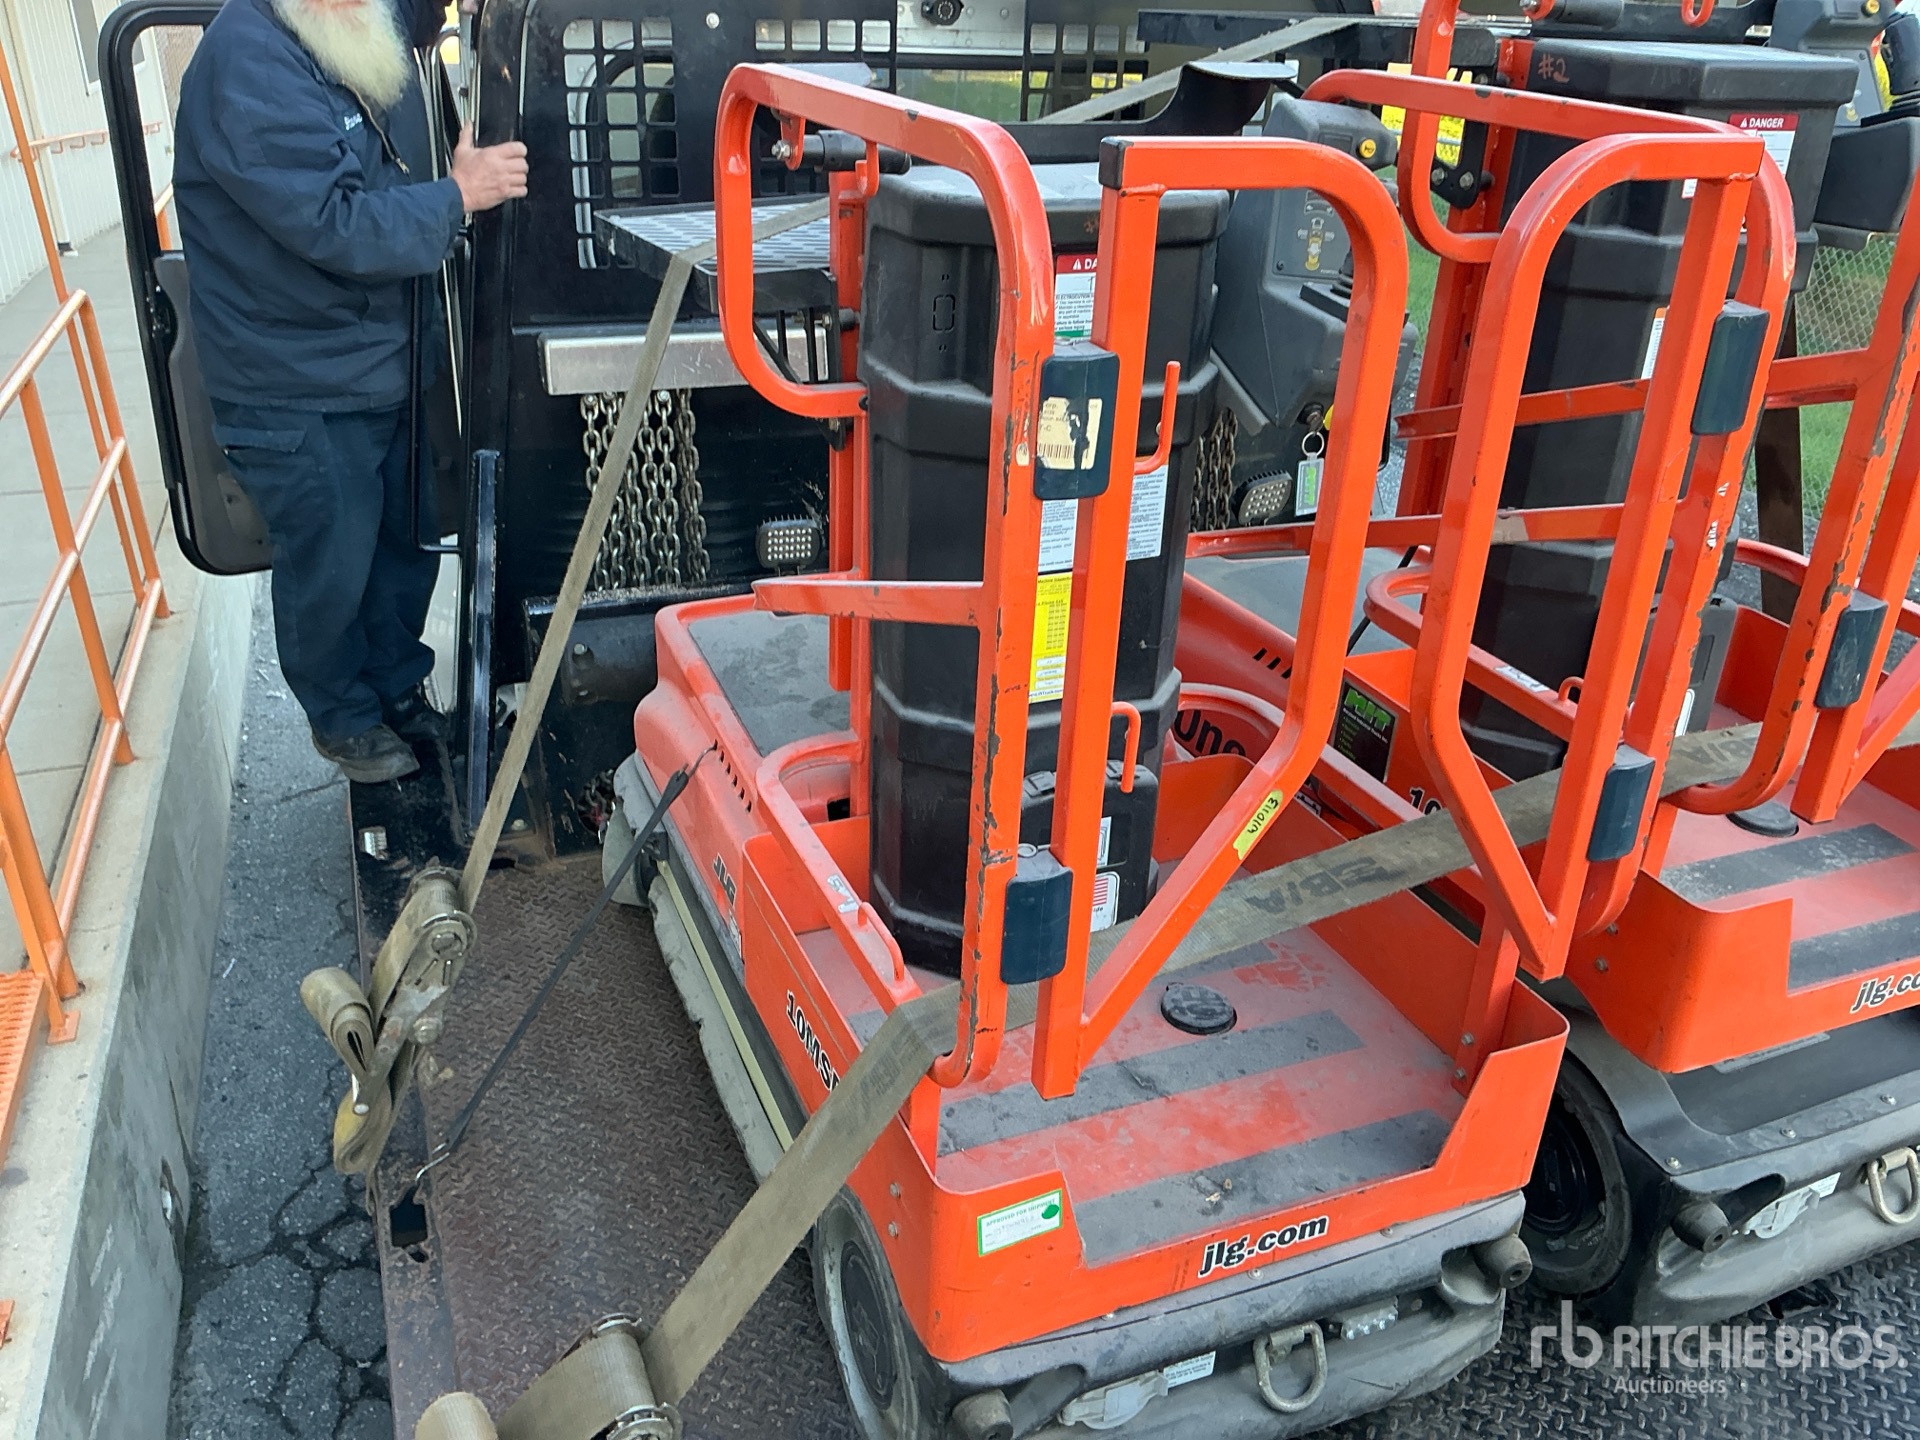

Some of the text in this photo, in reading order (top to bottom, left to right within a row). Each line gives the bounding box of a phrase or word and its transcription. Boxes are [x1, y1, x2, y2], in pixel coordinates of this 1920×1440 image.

[1538, 54, 1569, 83] #2
[1749, 117, 1784, 128] DANGER
[713, 852, 737, 907] JLG
[986, 1212, 1015, 1227] APPROVED
[1016, 1208, 1027, 1216] FOR
[1028, 1198, 1056, 1212] SHIPMENT
[1198, 1215, 1329, 1278] jlg.com
